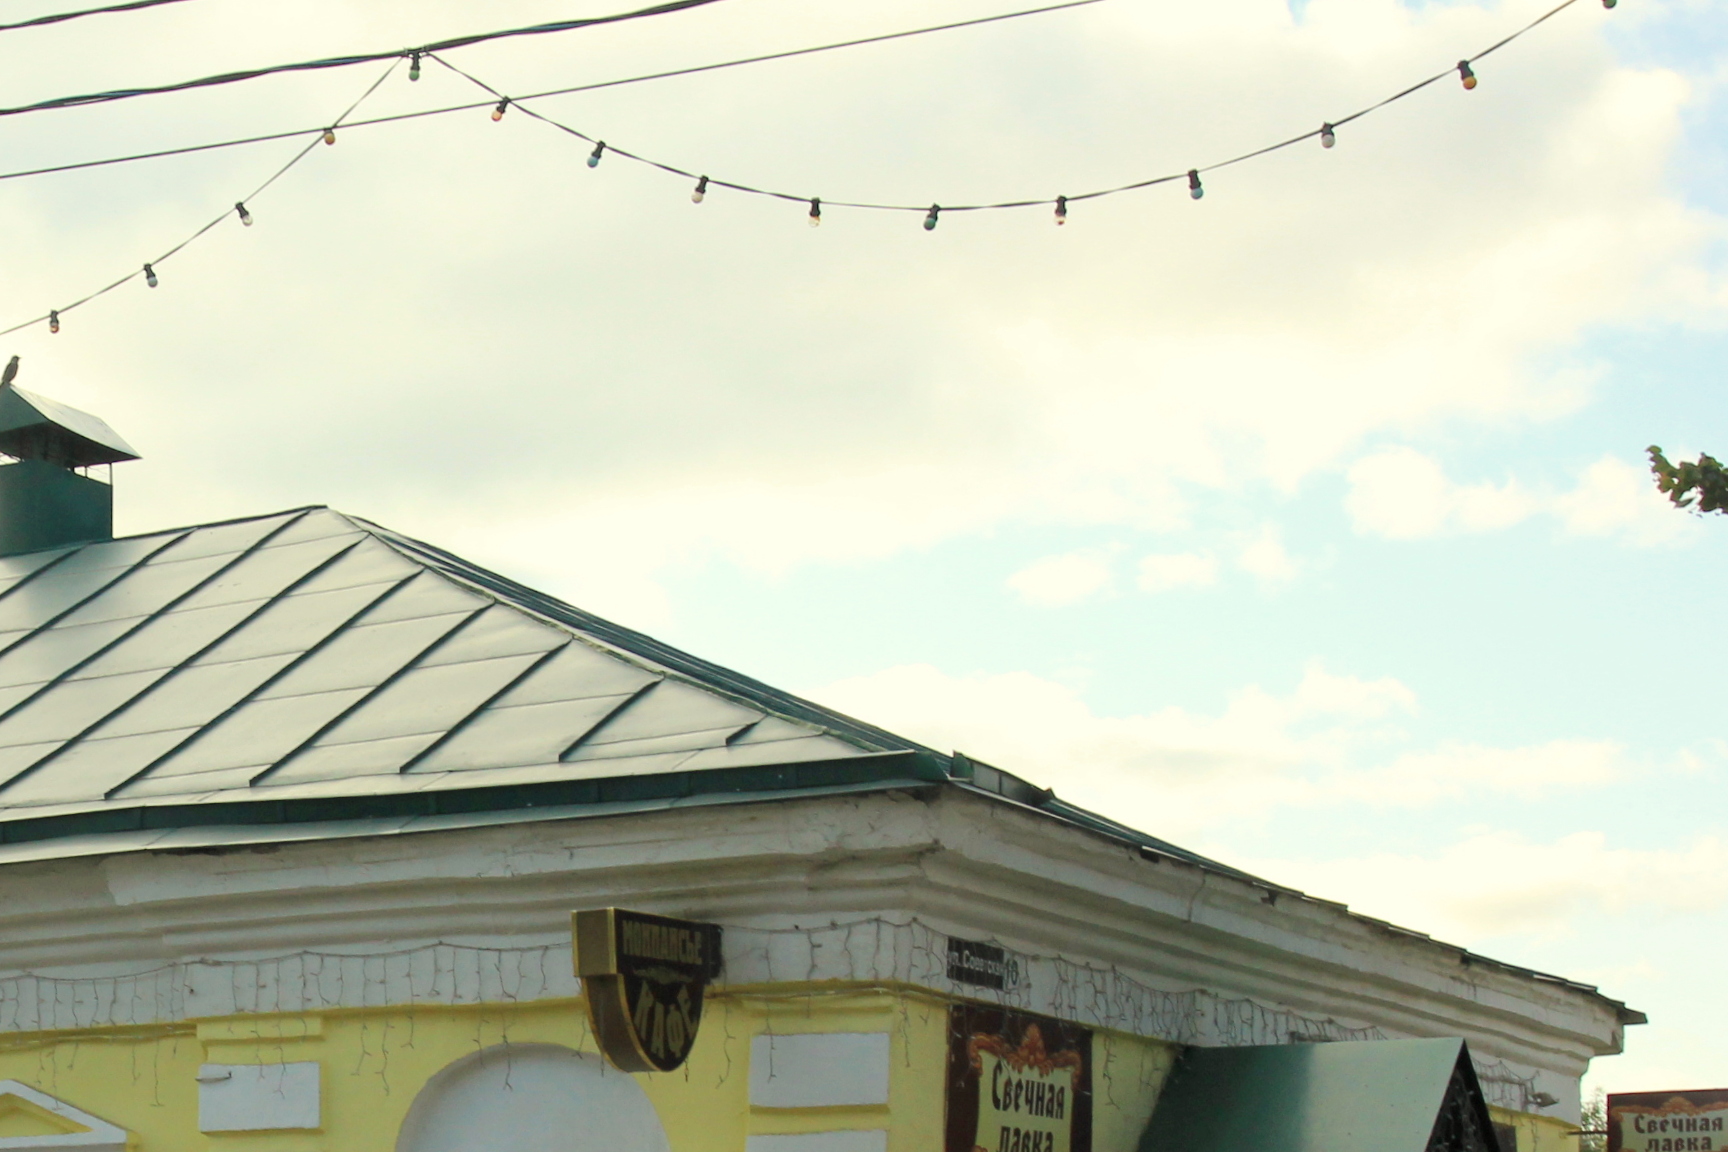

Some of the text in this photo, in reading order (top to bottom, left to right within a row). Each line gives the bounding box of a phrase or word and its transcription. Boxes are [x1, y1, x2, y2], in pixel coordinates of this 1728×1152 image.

[634, 980, 699, 1058] КАФЕ
[992, 1060, 1065, 1120] Свечная
[1634, 1114, 1723, 1134] Свечная
[1645, 1136, 1712, 1152] лавка
